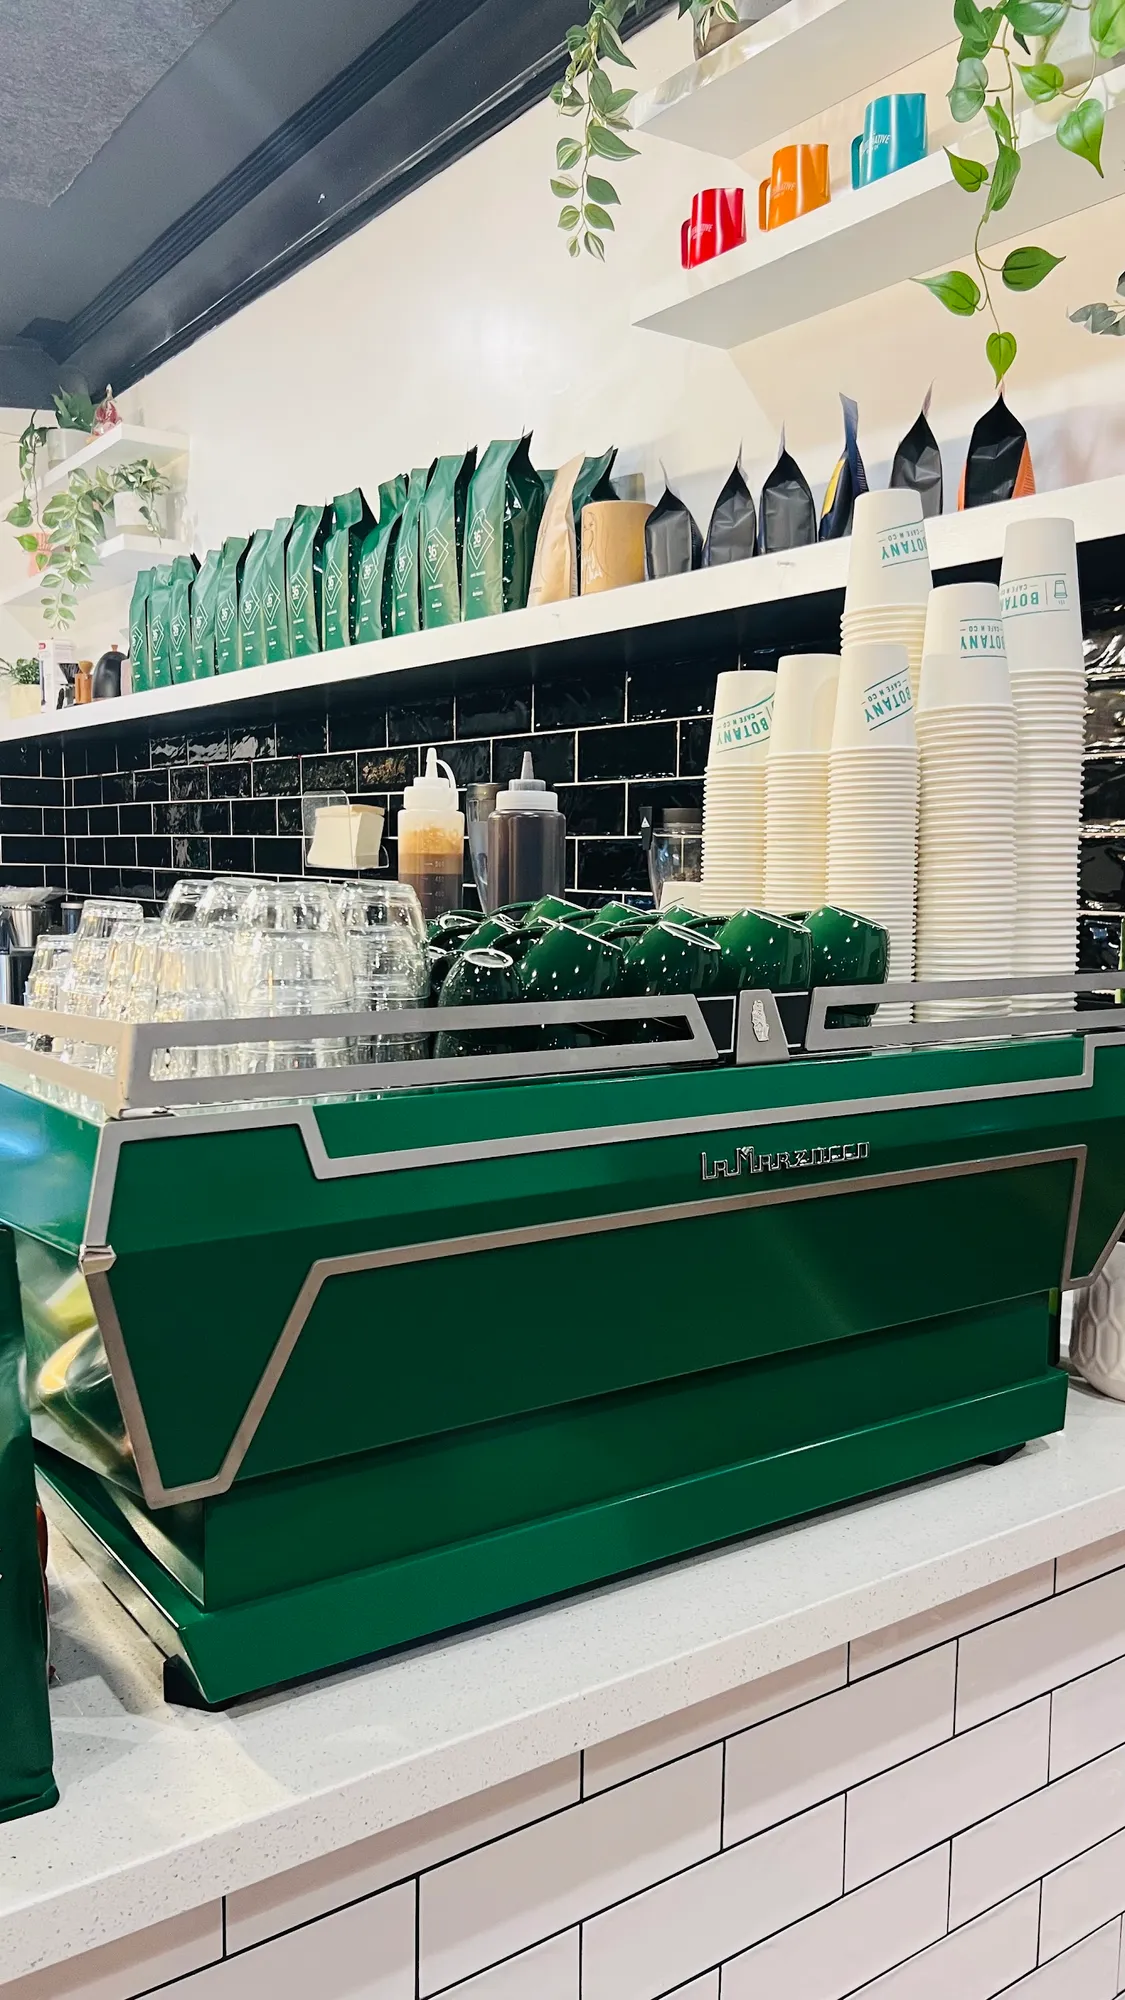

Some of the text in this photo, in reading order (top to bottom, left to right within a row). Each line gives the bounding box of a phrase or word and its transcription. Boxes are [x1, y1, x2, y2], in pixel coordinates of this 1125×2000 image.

[1000, 591, 1039, 612] BOTA
[885, 680, 902, 693] CAFE
[863, 686, 912, 723] BOTANY
[867, 692, 878, 702] CO
[738, 712, 756, 724] CAFE
[716, 717, 770, 746] BOTANY
